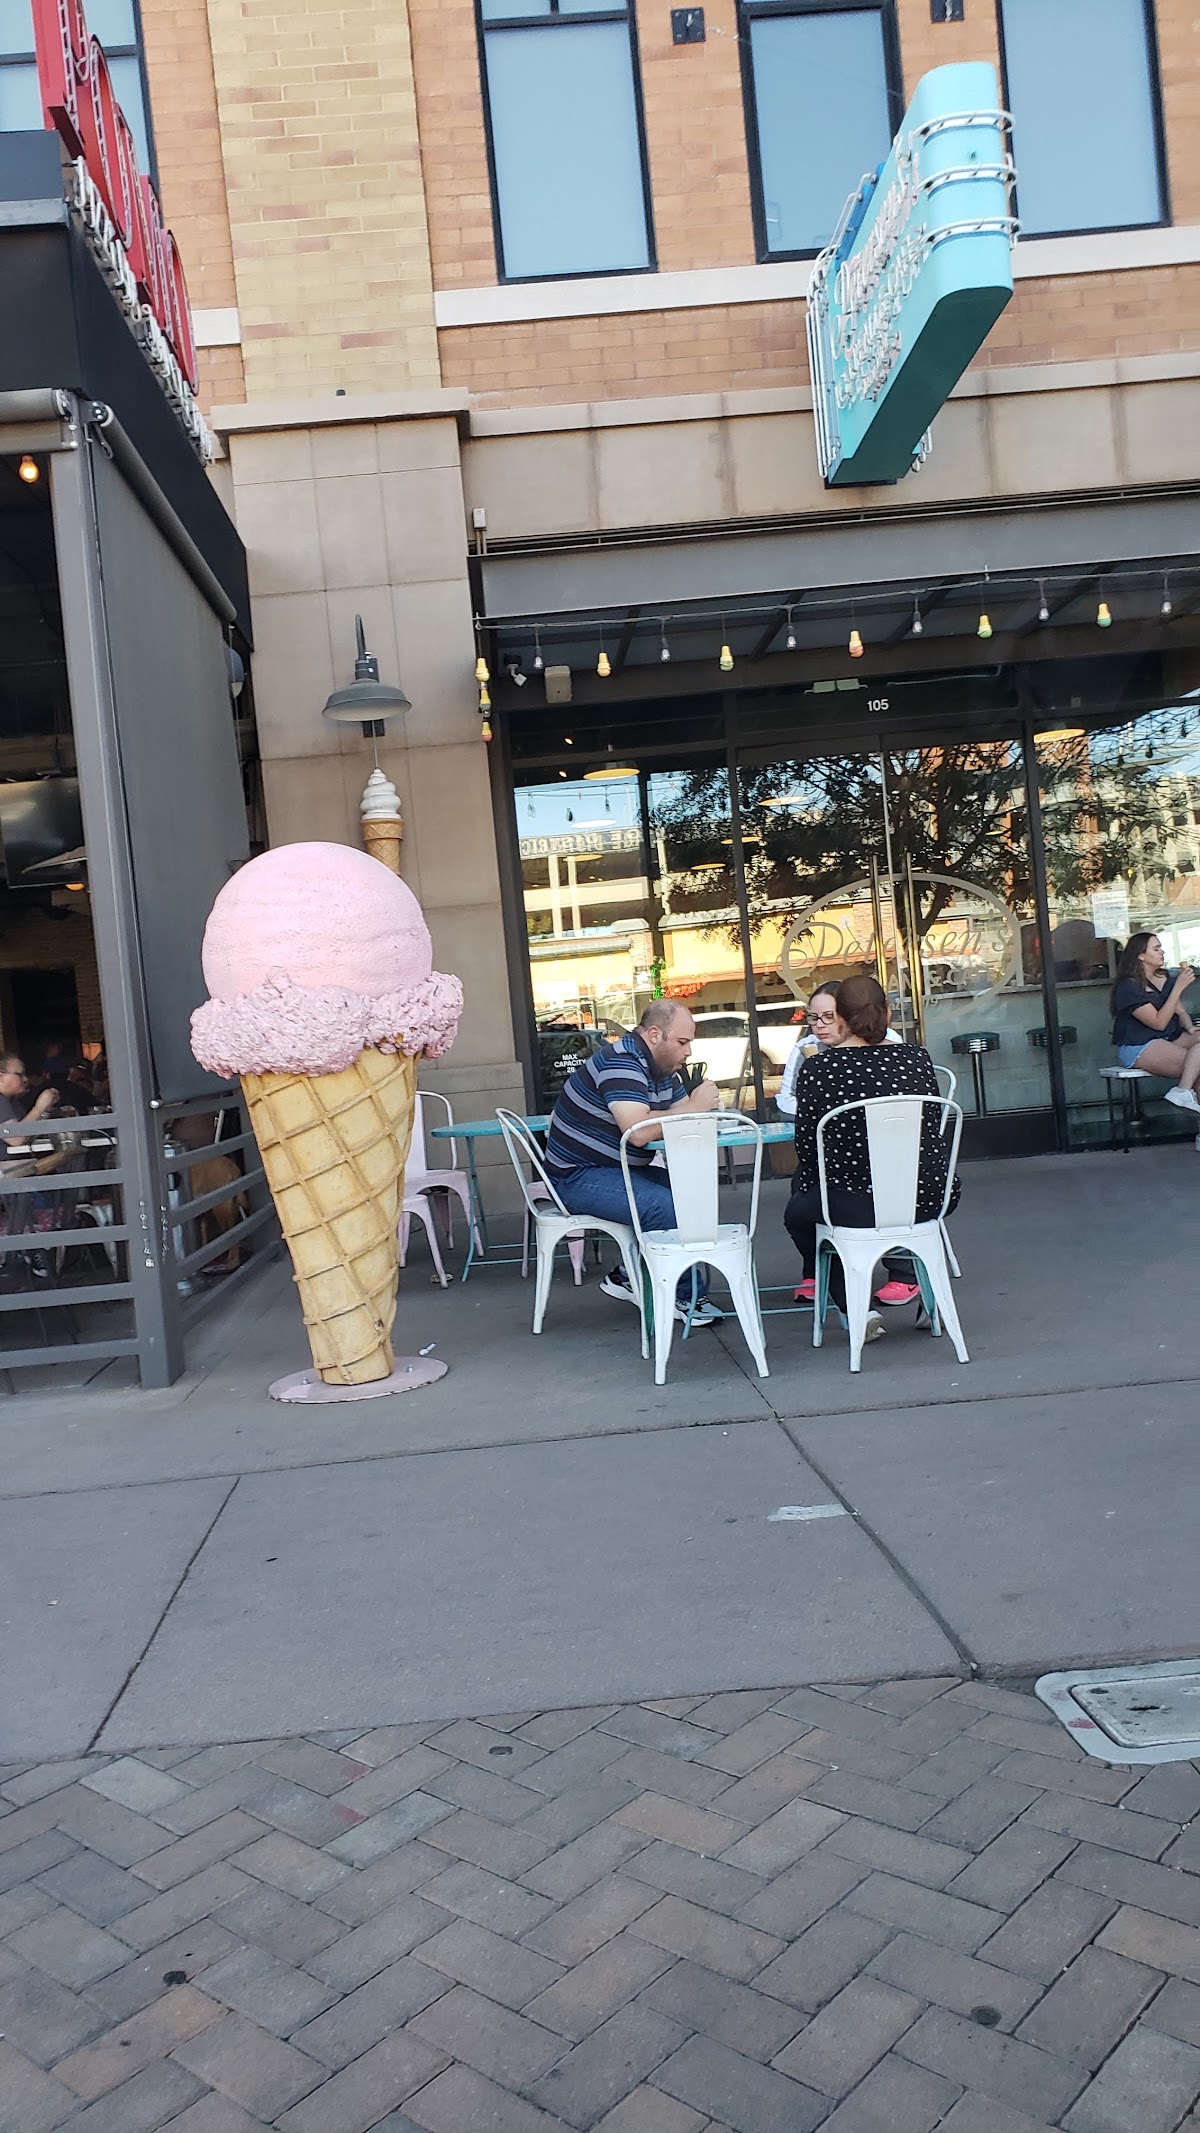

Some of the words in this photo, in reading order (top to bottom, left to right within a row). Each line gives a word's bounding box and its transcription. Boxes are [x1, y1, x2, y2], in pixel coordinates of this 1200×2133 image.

[867, 698, 890, 712] 105
[562, 1053, 579, 1061] MAX
[553, 1058, 587, 1068] CAPACITY
